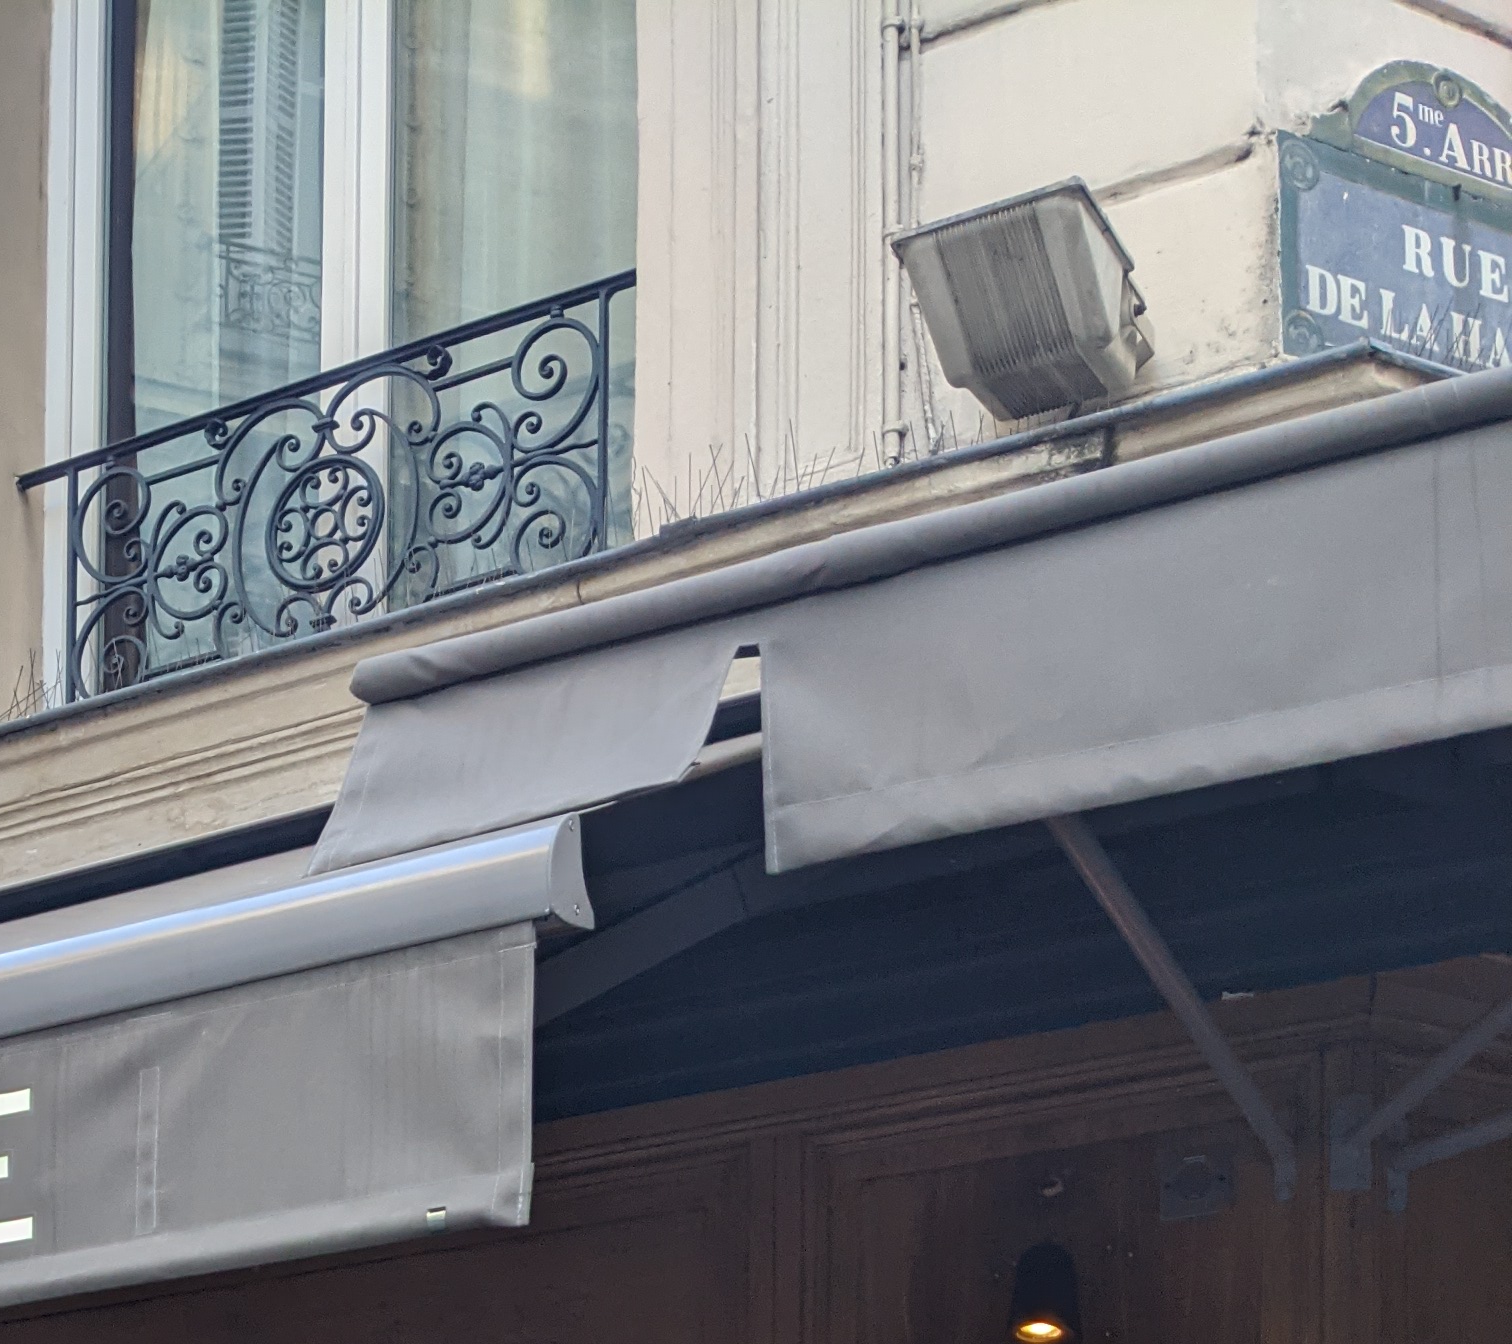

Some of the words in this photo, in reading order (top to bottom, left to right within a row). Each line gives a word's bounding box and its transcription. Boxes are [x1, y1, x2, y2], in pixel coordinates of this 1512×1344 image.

[1401, 224, 1509, 303] RUE
[1305, 264, 1369, 330] DE
[1379, 288, 1439, 351] LA
